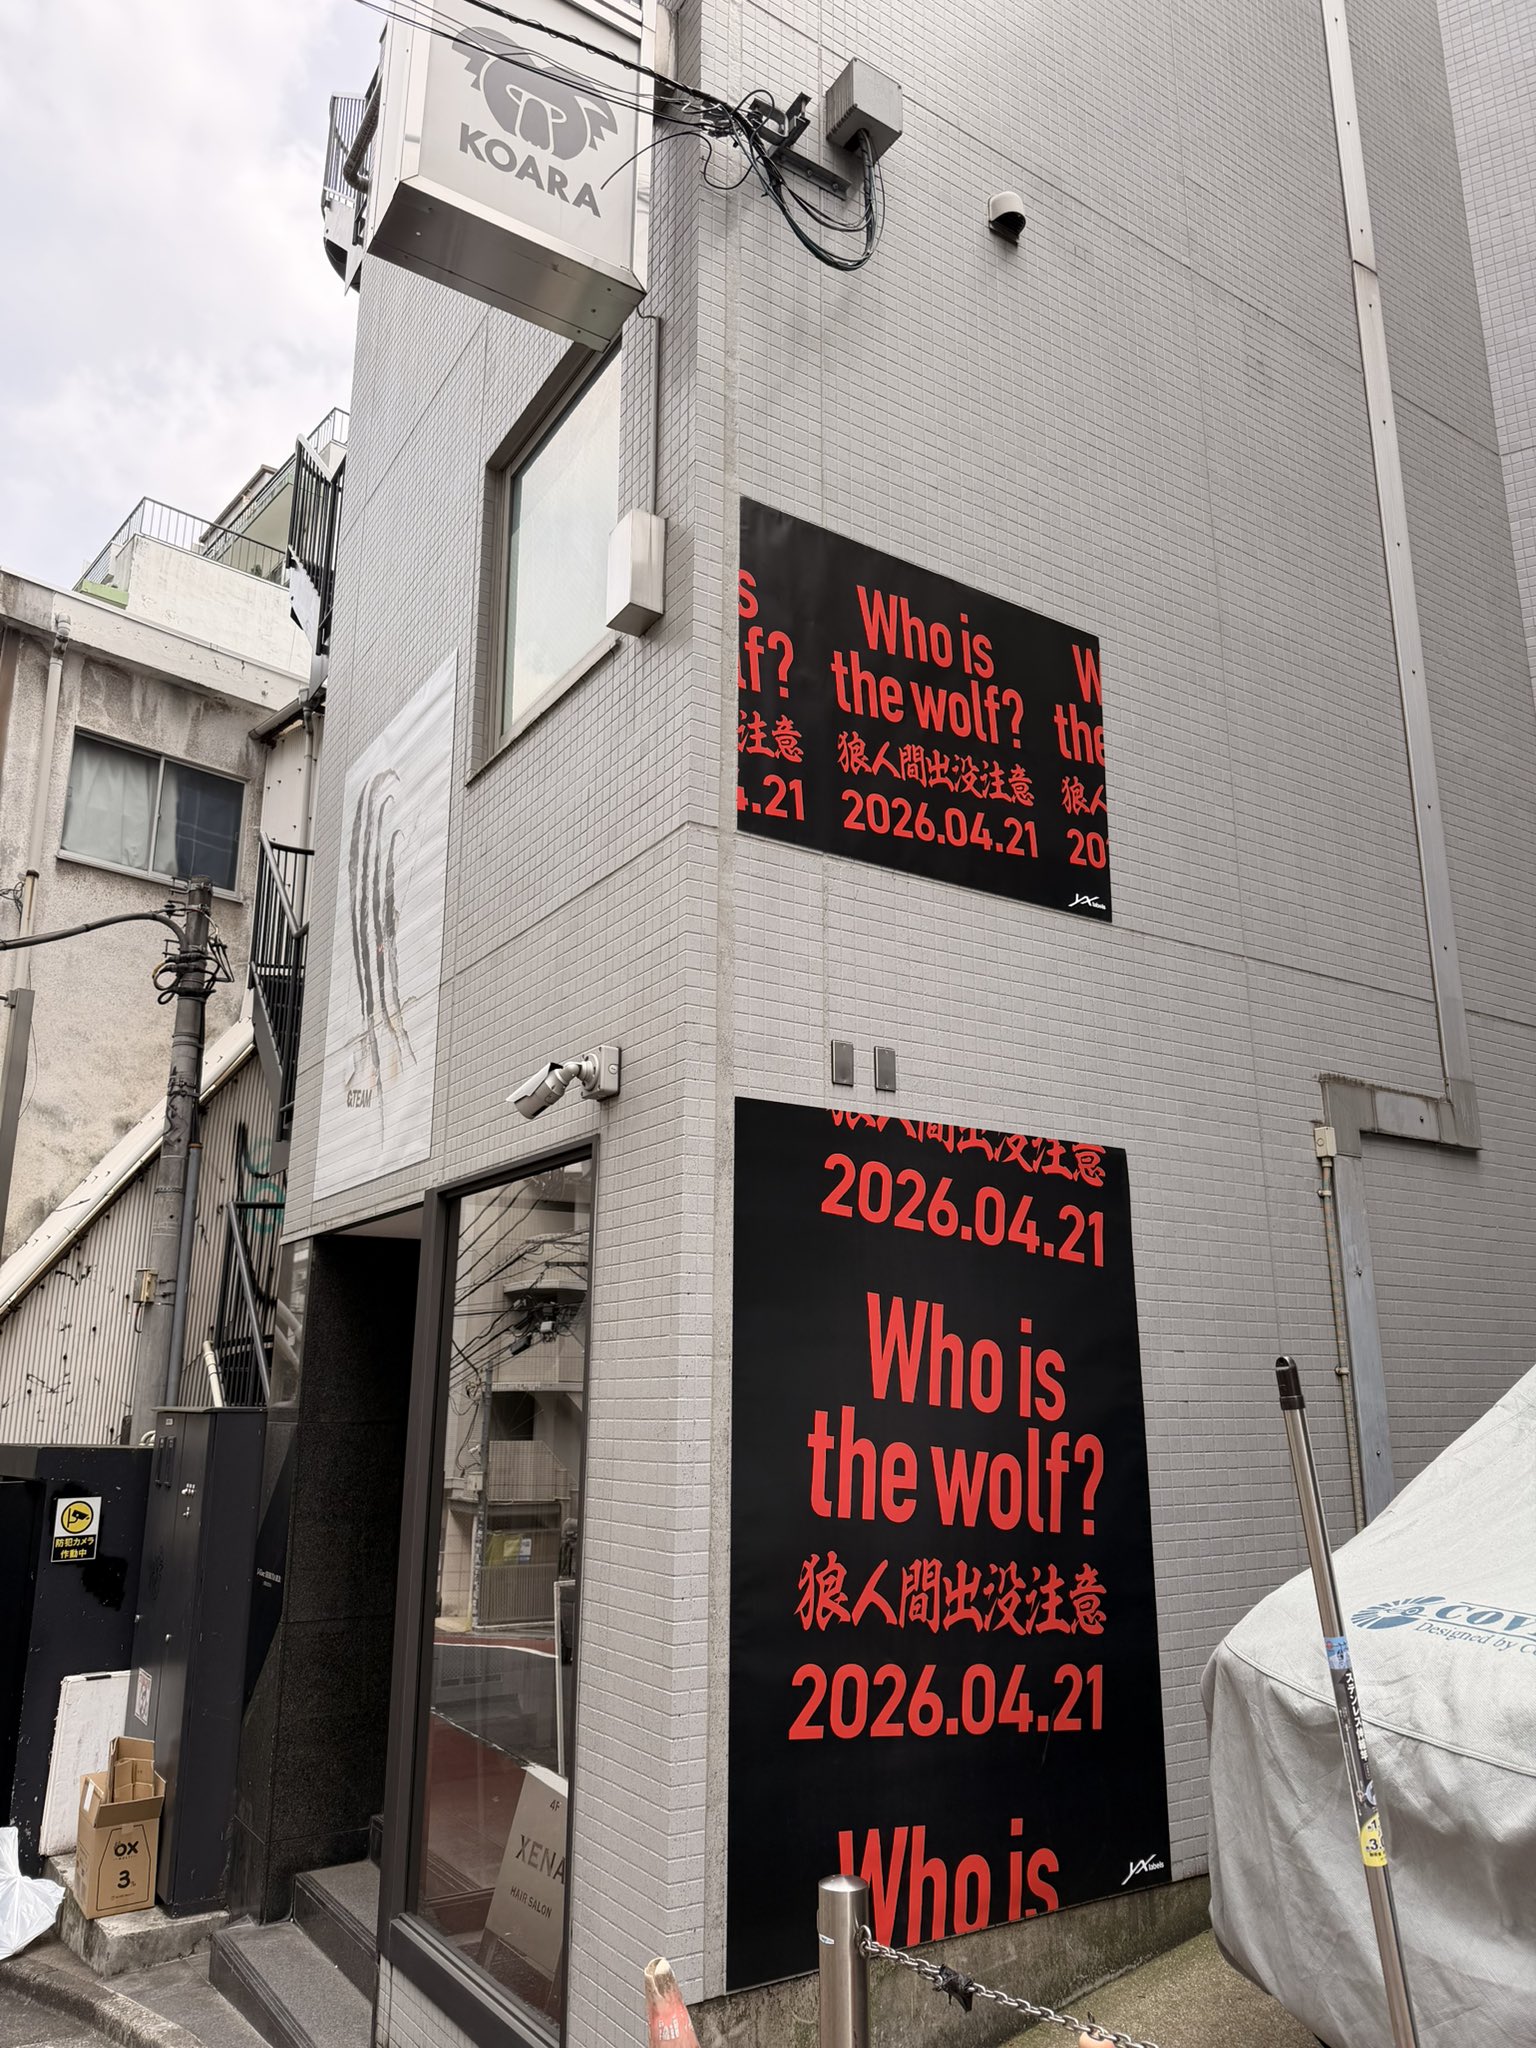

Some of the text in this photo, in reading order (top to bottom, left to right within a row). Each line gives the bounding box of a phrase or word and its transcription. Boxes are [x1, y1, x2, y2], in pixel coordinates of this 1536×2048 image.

[459, 122, 602, 219] KOARA
[856, 585, 995, 680] Who is
[831, 651, 1024, 749] the wolf?
[837, 731, 1035, 807] 狼人間出没注意
[841, 789, 1038, 859] 2026.04.21
[1066, 828, 1109, 870] 20
[820, 1153, 1104, 1267] 2026.04.21
[866, 1292, 1066, 1422] Who is
[807, 1405, 1104, 1536] the wolf?
[55, 1536, 95, 1548] 防犯カメラ
[60, 1548, 88, 1559] 作動中
[795, 1551, 1107, 1637] 狼人間出没注意
[1435, 1604, 1536, 1638] COV
[1415, 1621, 1493, 1645] Designed
[1494, 1636, 1517, 1652] by
[788, 1663, 1103, 1740] 2026.04.21
[510, 1885, 552, 1919] HAIR SALON
[838, 1817, 1059, 1948] Who is
